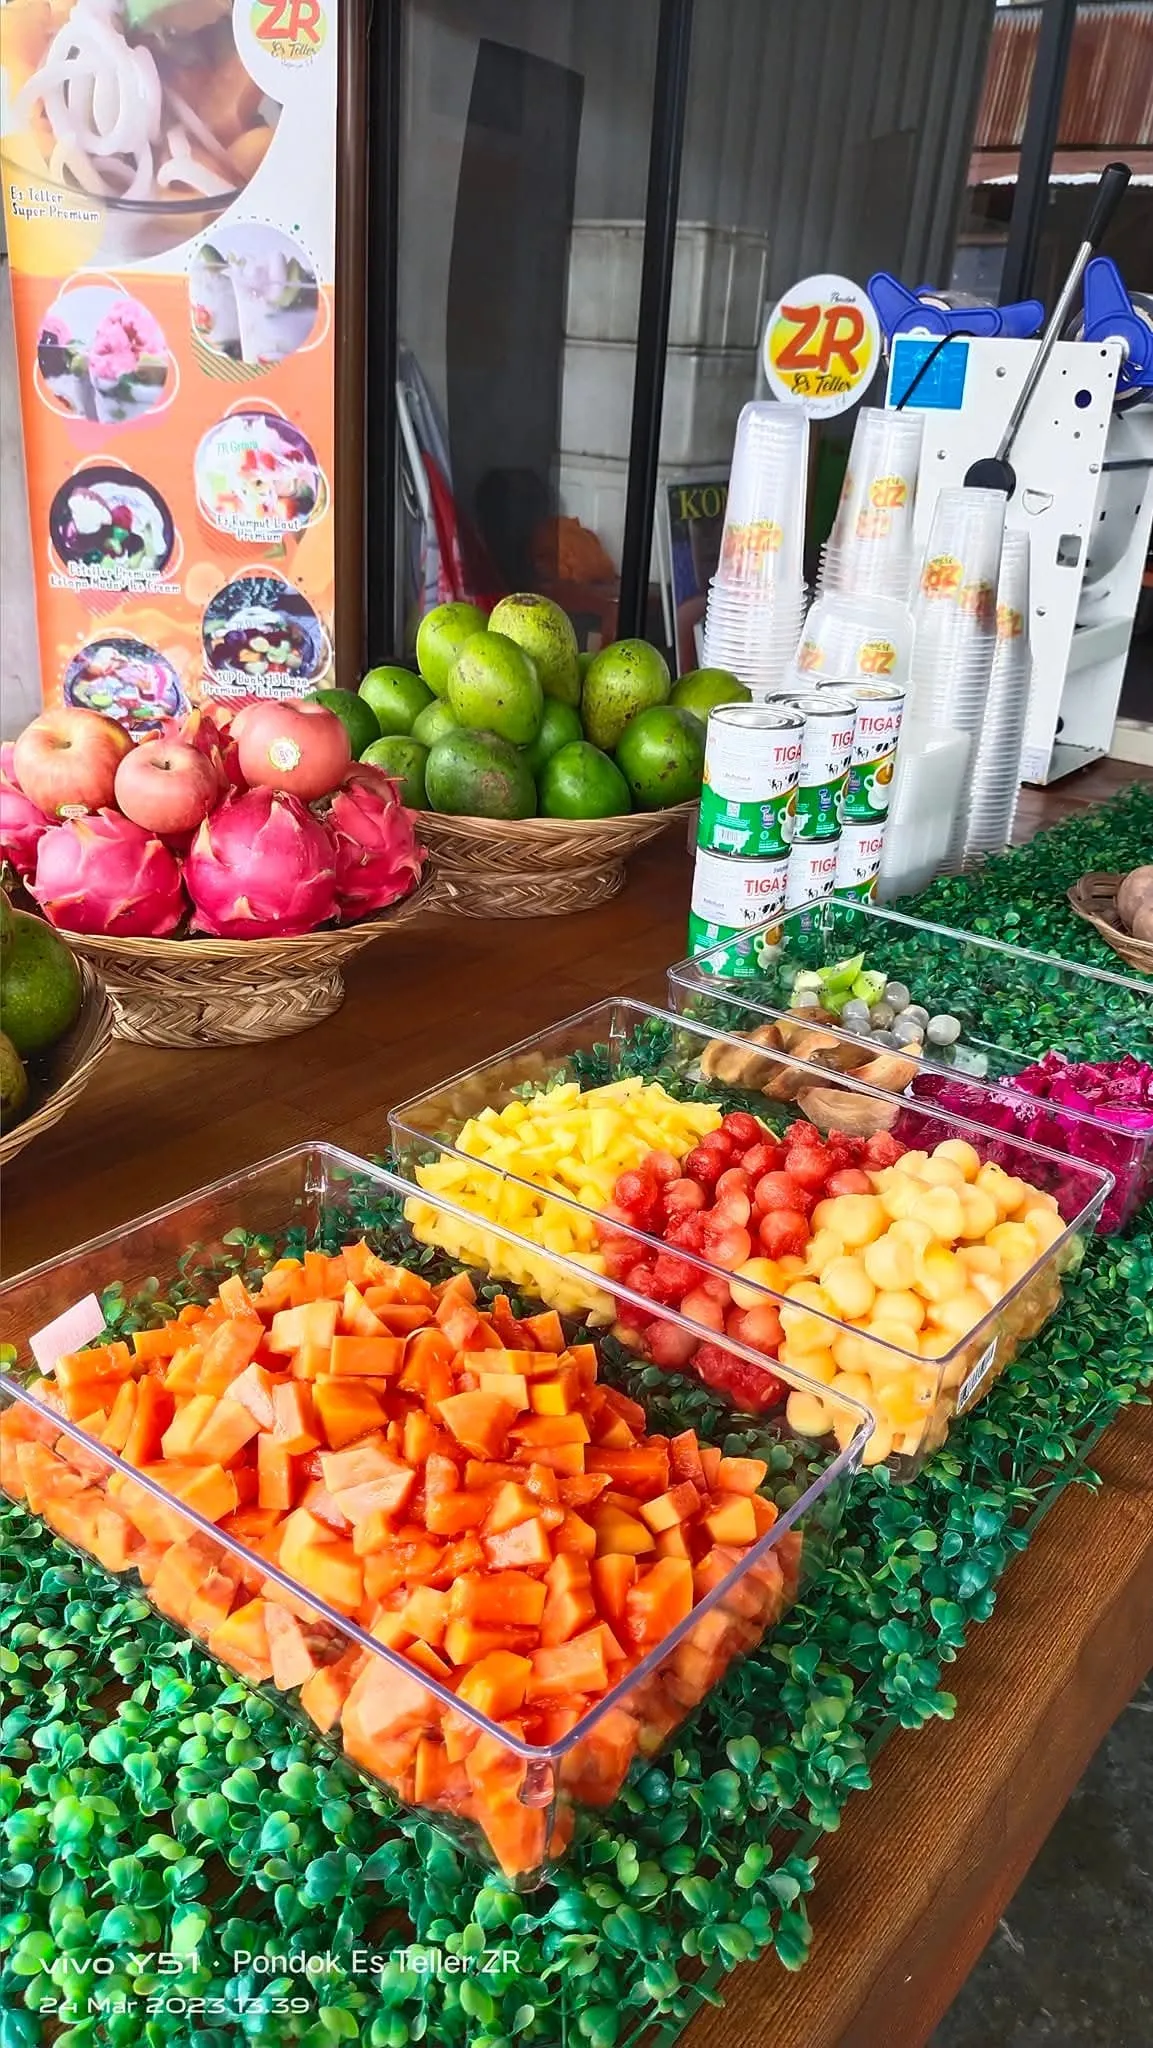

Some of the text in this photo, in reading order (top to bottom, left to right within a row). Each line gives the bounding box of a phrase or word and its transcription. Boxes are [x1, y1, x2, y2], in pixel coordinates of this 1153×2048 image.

[255, 0, 321, 44] ZR
[10, 186, 64, 201] Es Teller
[12, 202, 99, 221] Super Premium
[775, 304, 866, 376] ZR
[815, 374, 852, 395] Teller
[274, 517, 299, 530] Laut
[237, 529, 281, 541] Premium
[858, 716, 893, 732] TIGA
[810, 856, 837, 874] TIGA
[743, 878, 780, 894] TIGA
